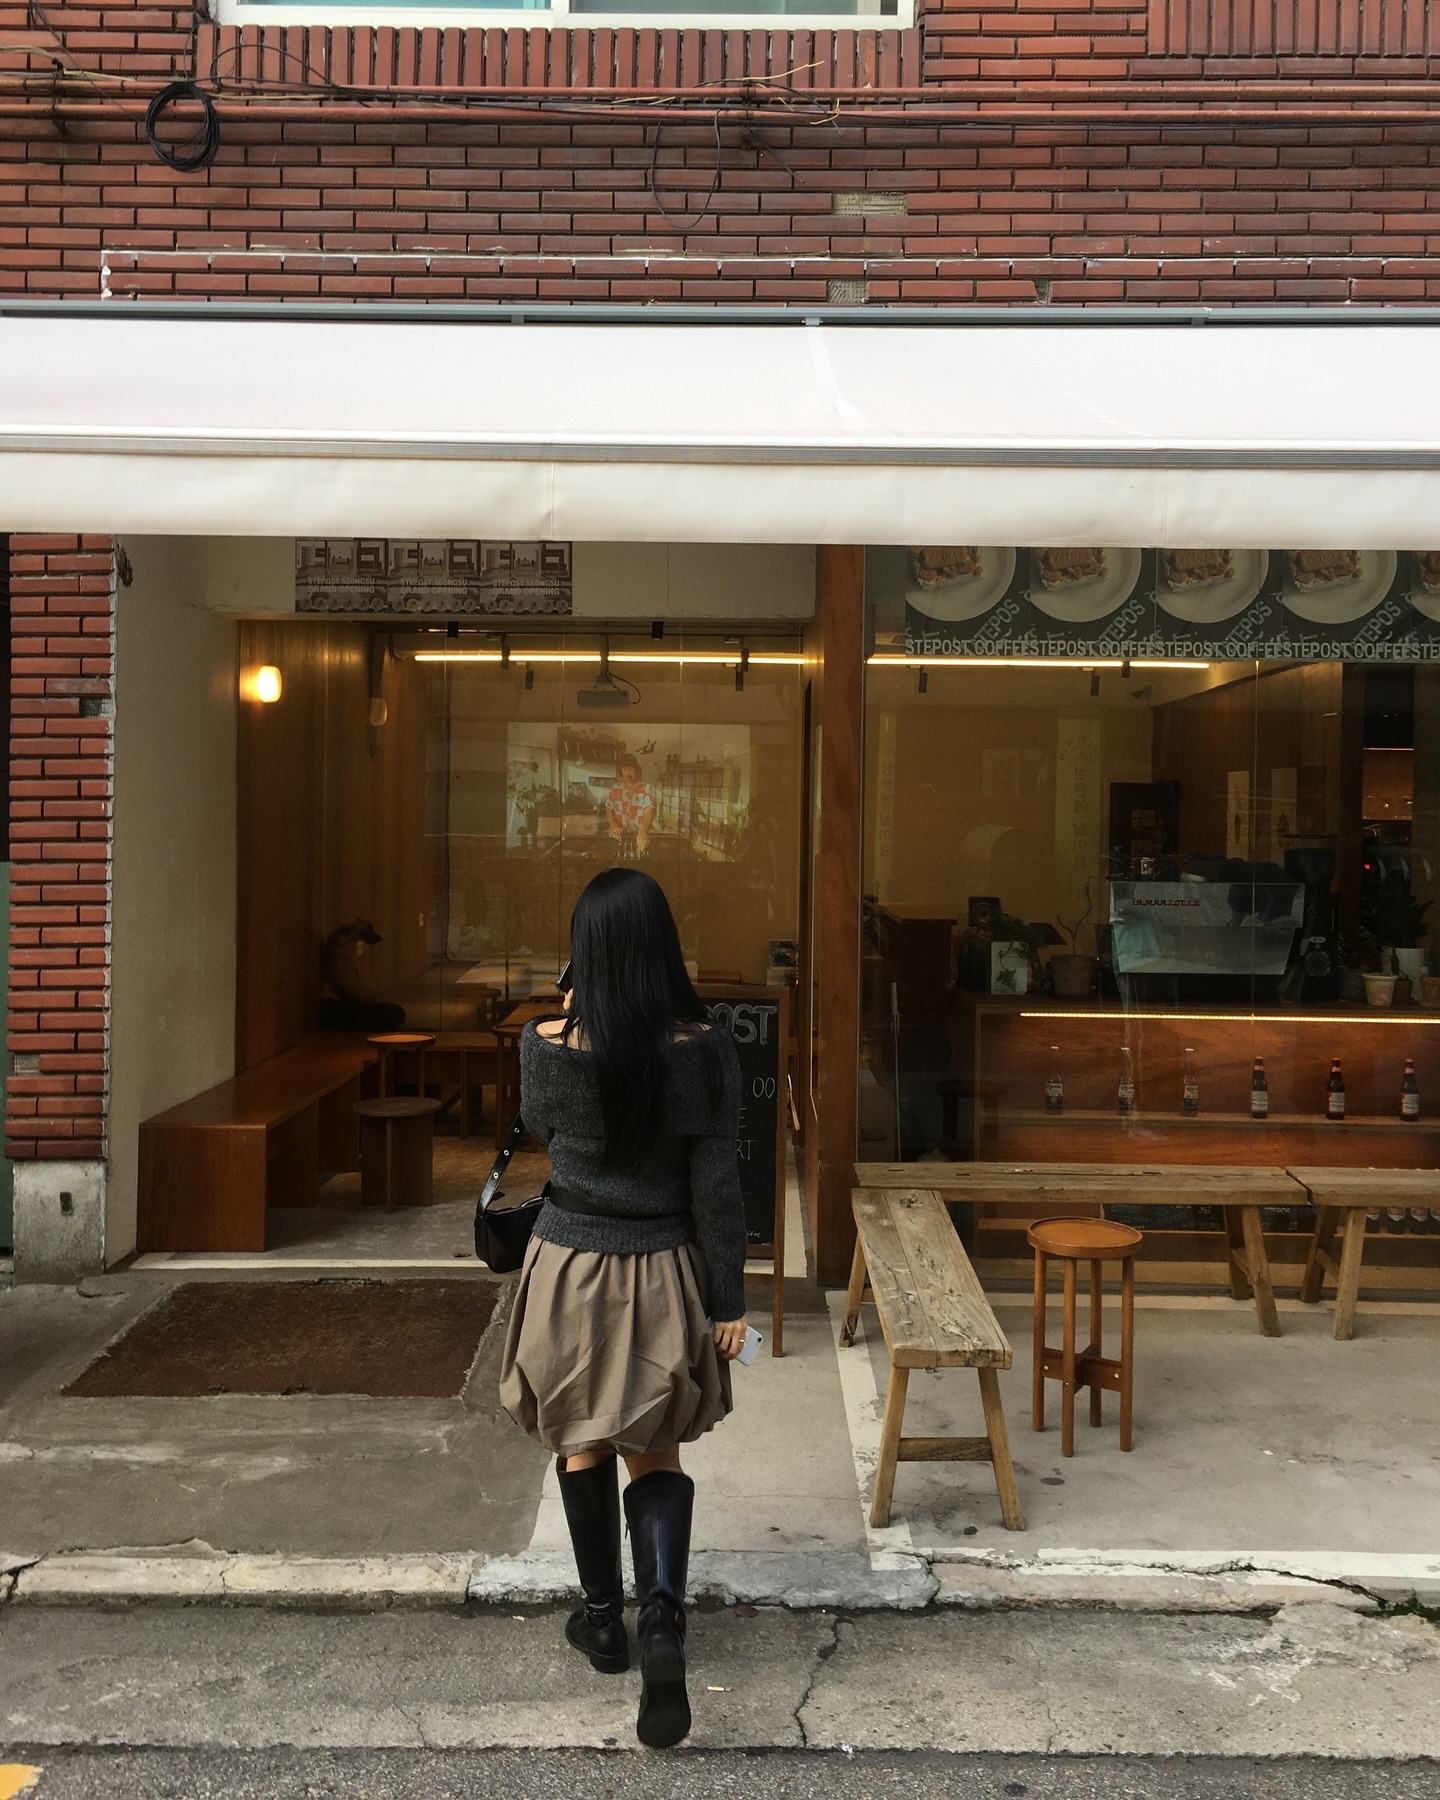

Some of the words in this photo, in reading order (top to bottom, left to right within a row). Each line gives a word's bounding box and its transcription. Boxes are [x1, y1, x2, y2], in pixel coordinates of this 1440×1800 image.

[905, 639, 970, 656] STEPOST
[1030, 640, 1096, 657] STEPOST
[1156, 641, 1222, 658] STEPOST
[1283, 642, 1349, 659] STEPOST
[1411, 643, 1440, 660] STE
[704, 1002, 778, 1046] OST
